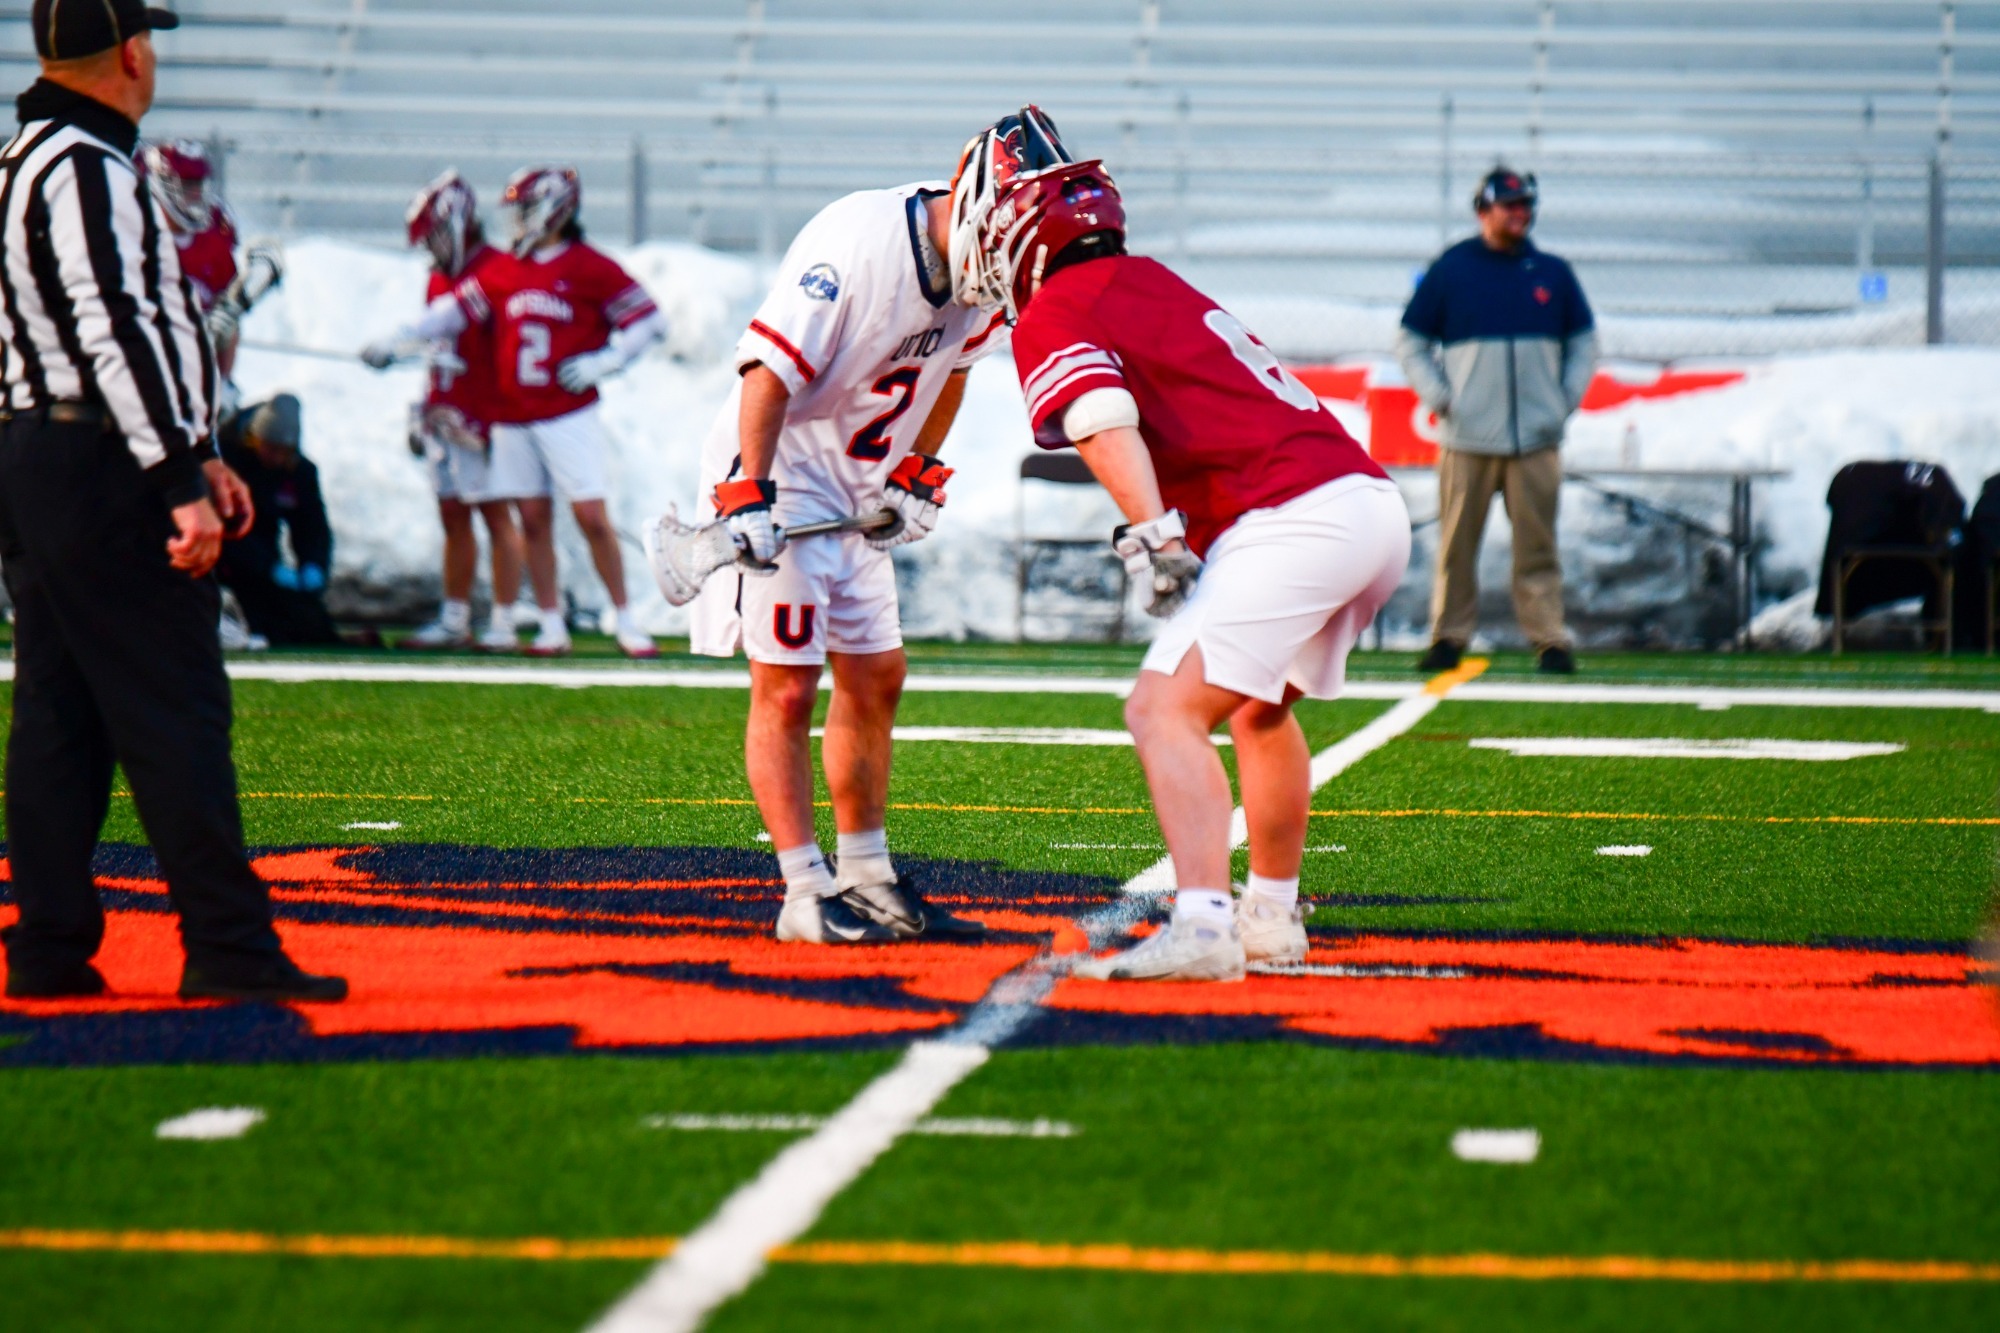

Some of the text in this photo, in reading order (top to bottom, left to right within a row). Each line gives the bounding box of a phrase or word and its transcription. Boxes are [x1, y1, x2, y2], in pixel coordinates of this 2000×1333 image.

[517, 321, 551, 387] 2
[890, 322, 946, 361] UTIC
[846, 365, 922, 462] 2
[773, 603, 816, 650] U
